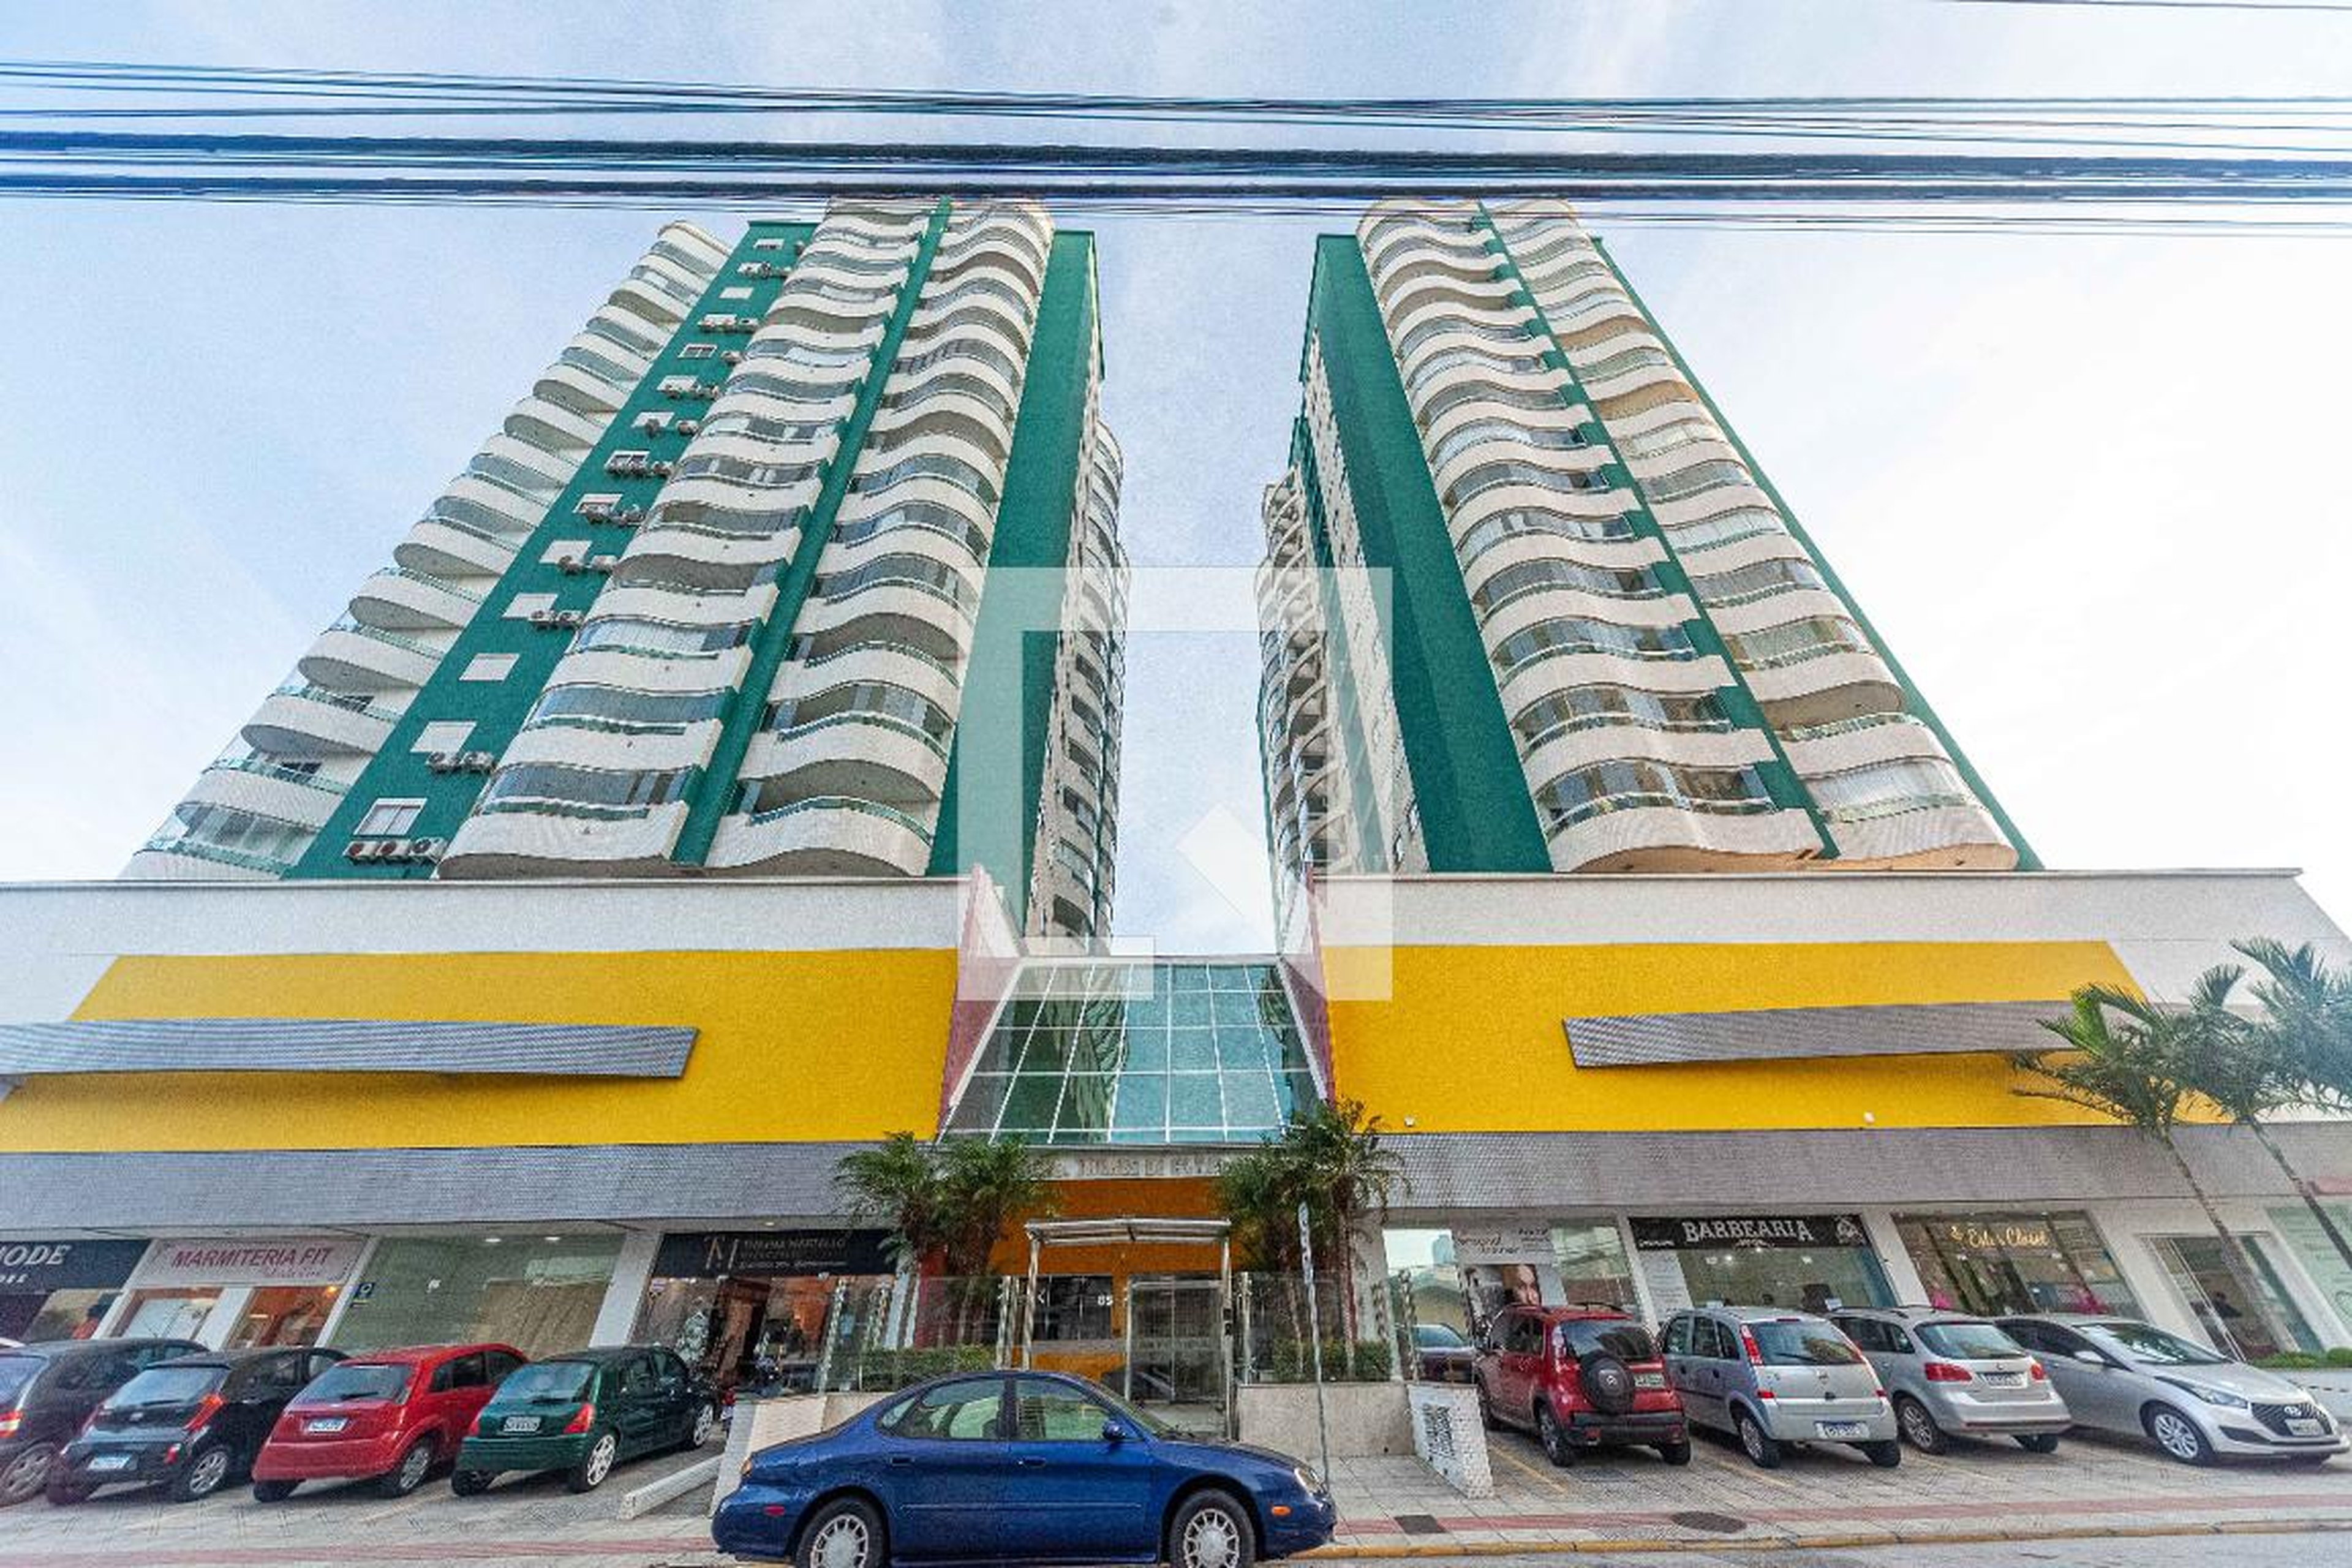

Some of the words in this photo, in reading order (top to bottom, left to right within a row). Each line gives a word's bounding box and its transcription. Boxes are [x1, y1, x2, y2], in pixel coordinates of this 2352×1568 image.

[1682, 1220, 1815, 1243] BARBEARIA
[172, 1248, 297, 1268] MARMITERIA
[299, 1246, 334, 1266] FIT
